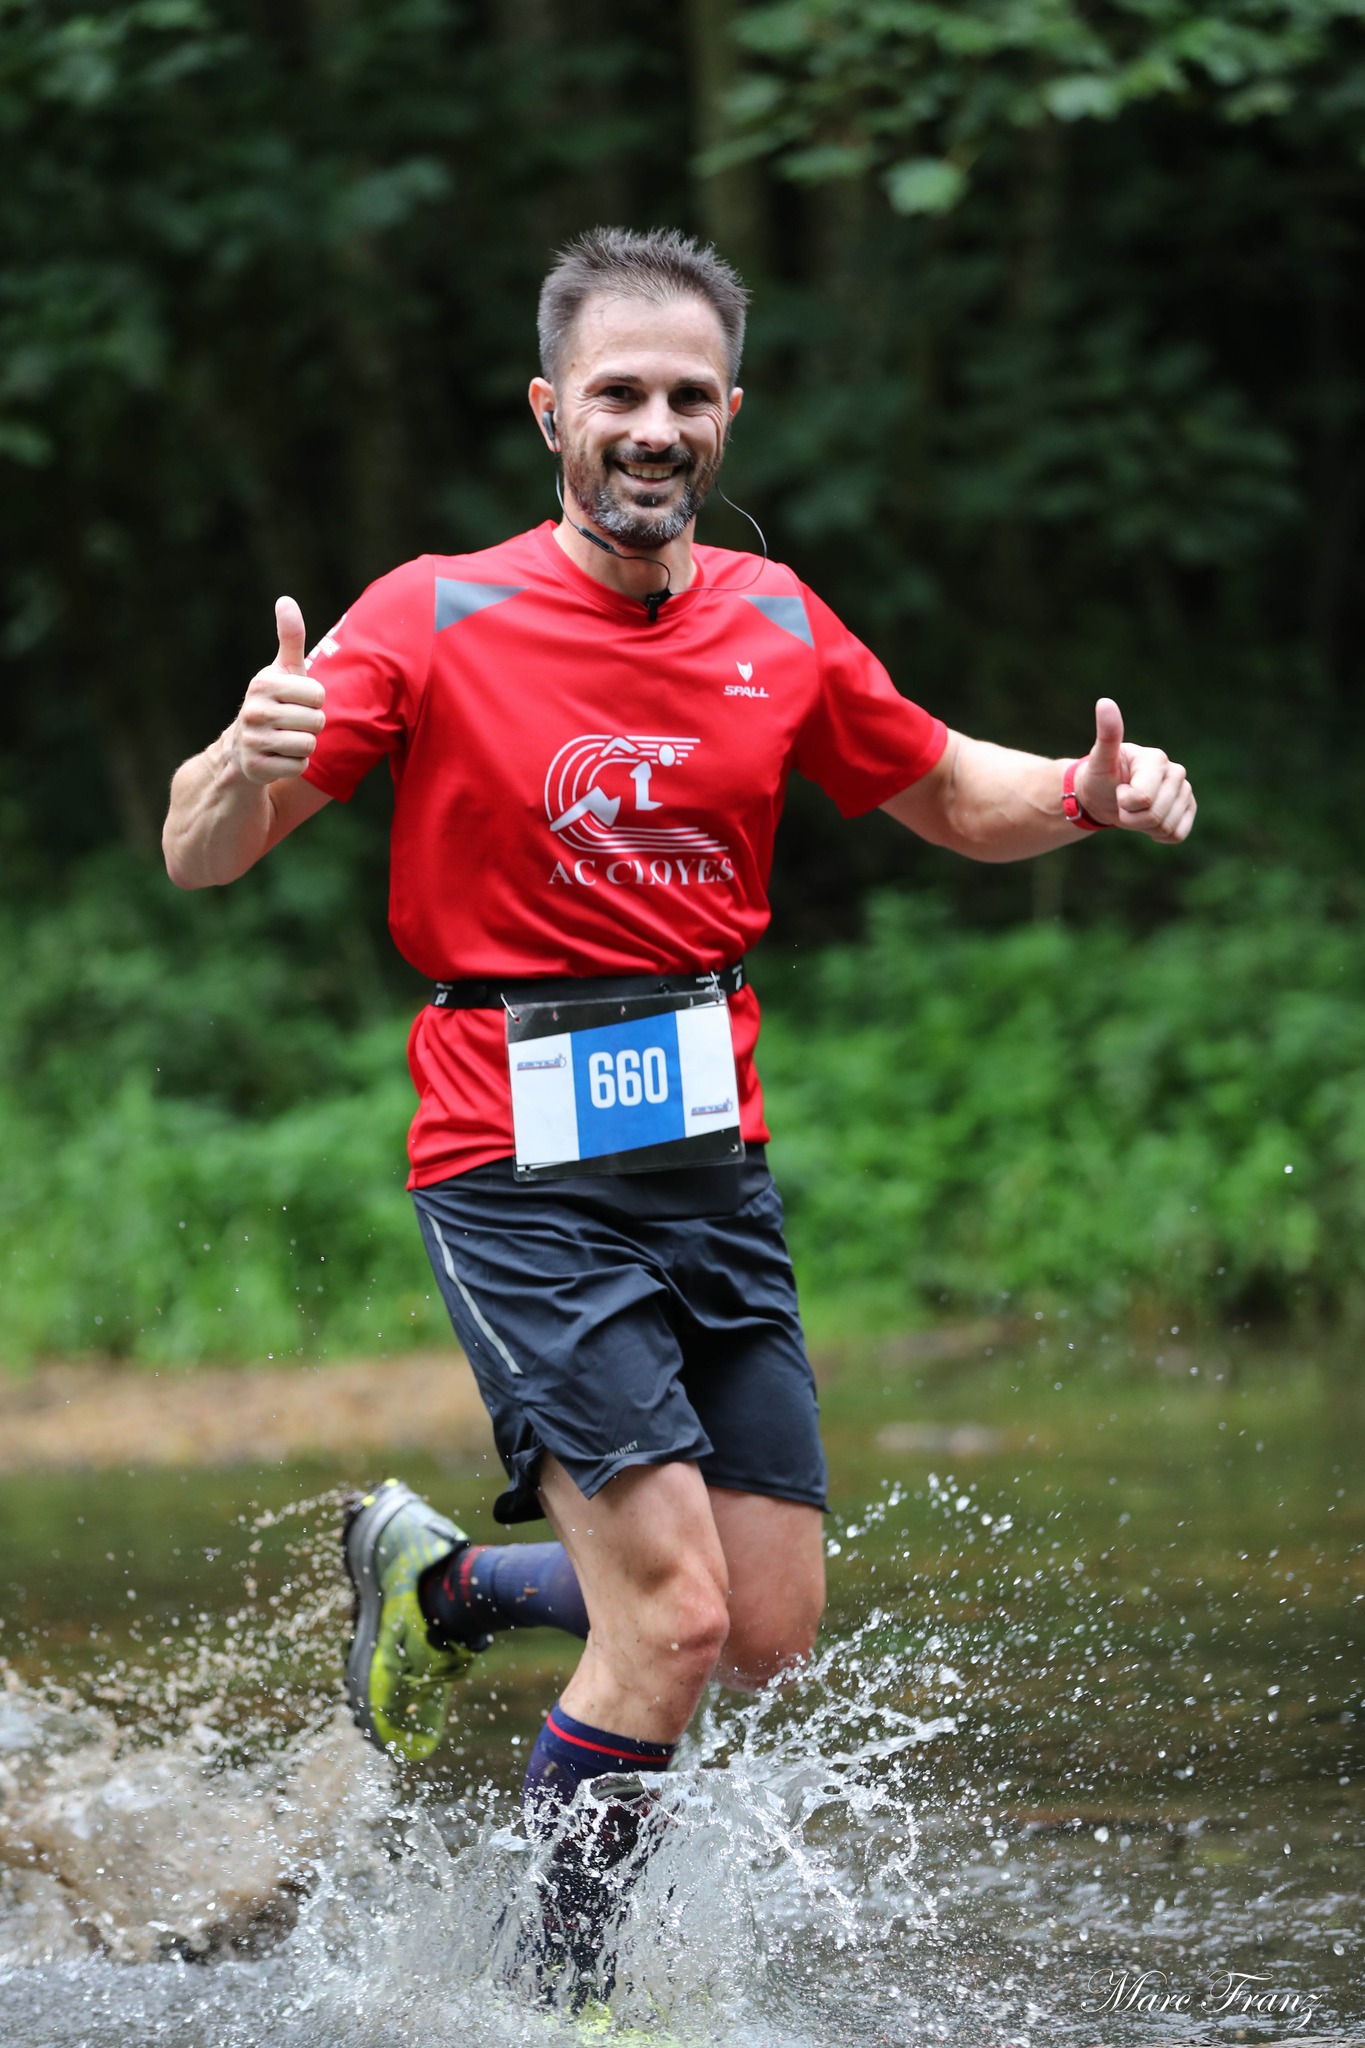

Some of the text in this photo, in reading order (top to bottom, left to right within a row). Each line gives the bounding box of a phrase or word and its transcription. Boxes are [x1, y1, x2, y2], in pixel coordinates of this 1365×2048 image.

[723, 684, 769, 698] SPALL
[548, 857, 735, 886] AC CLOYES
[589, 1047, 668, 1109] 660
